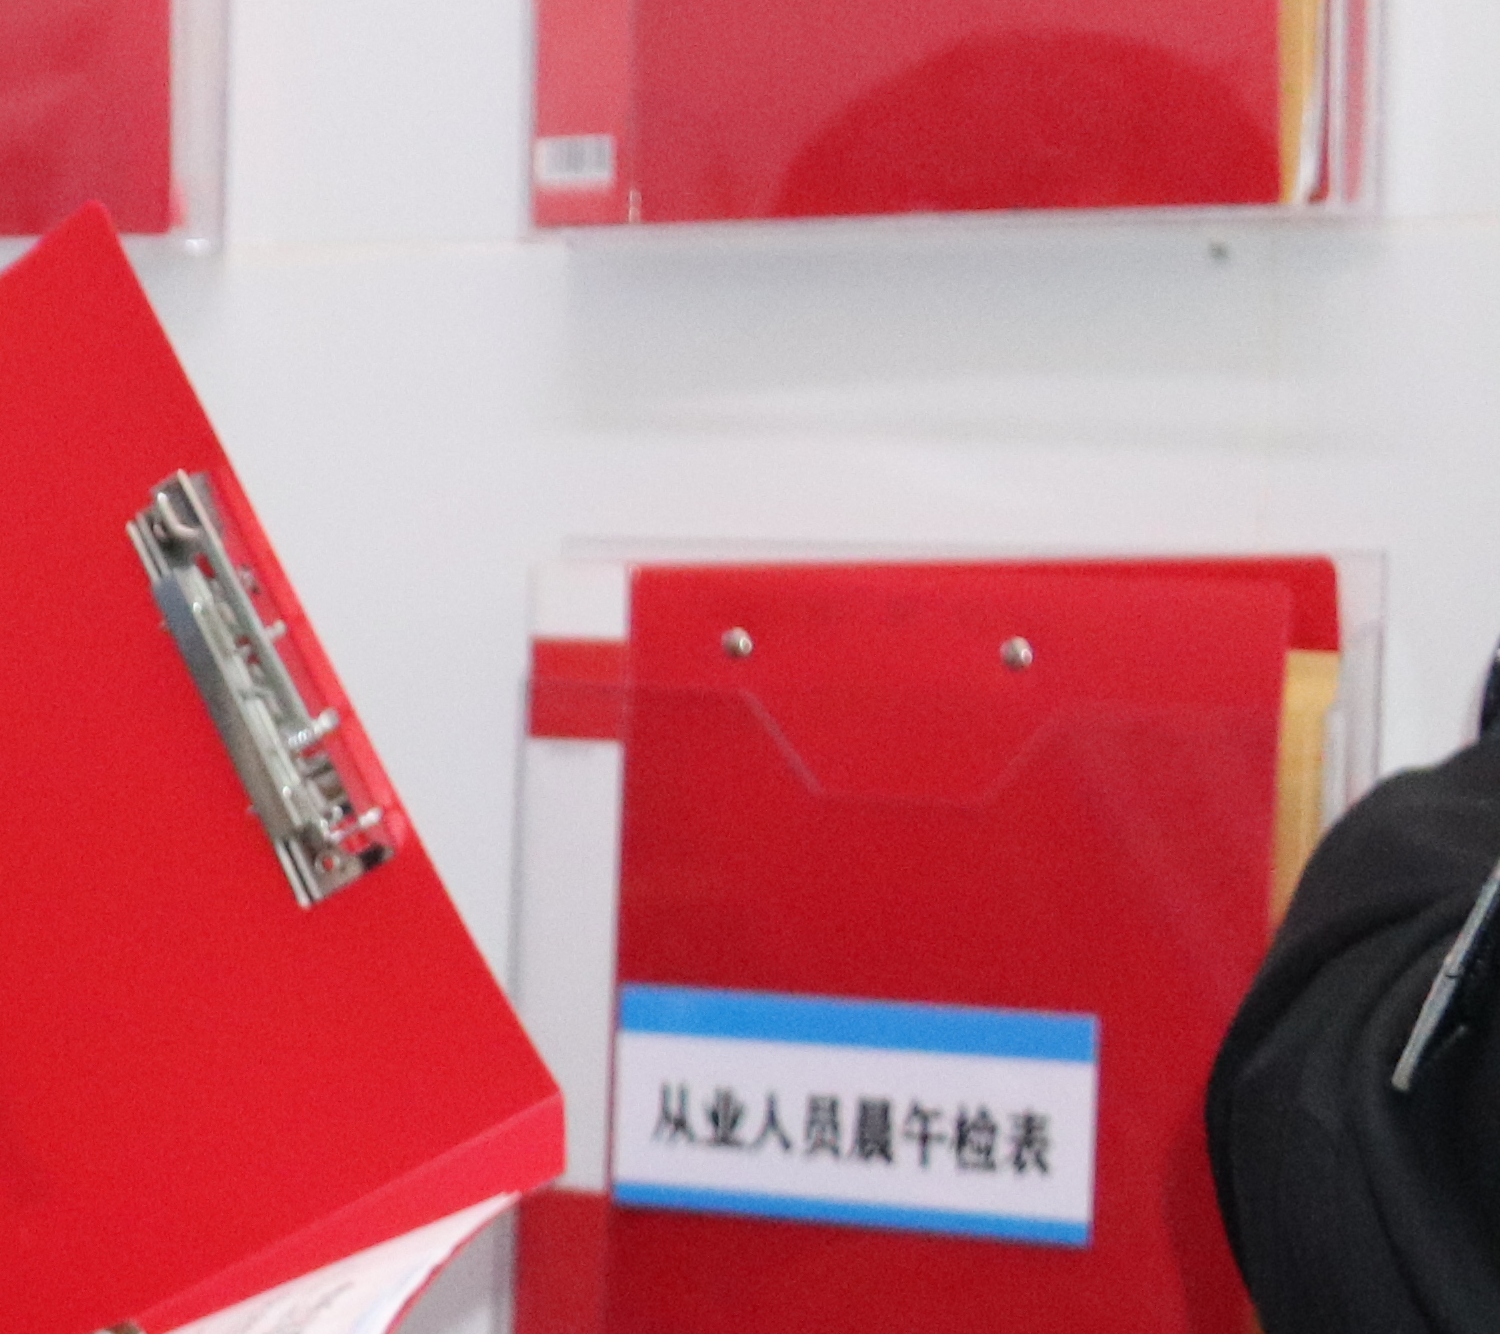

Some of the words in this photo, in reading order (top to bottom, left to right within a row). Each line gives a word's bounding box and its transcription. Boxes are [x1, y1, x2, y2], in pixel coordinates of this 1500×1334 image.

[653, 1081, 1053, 1175] 从业人员晨午检表
